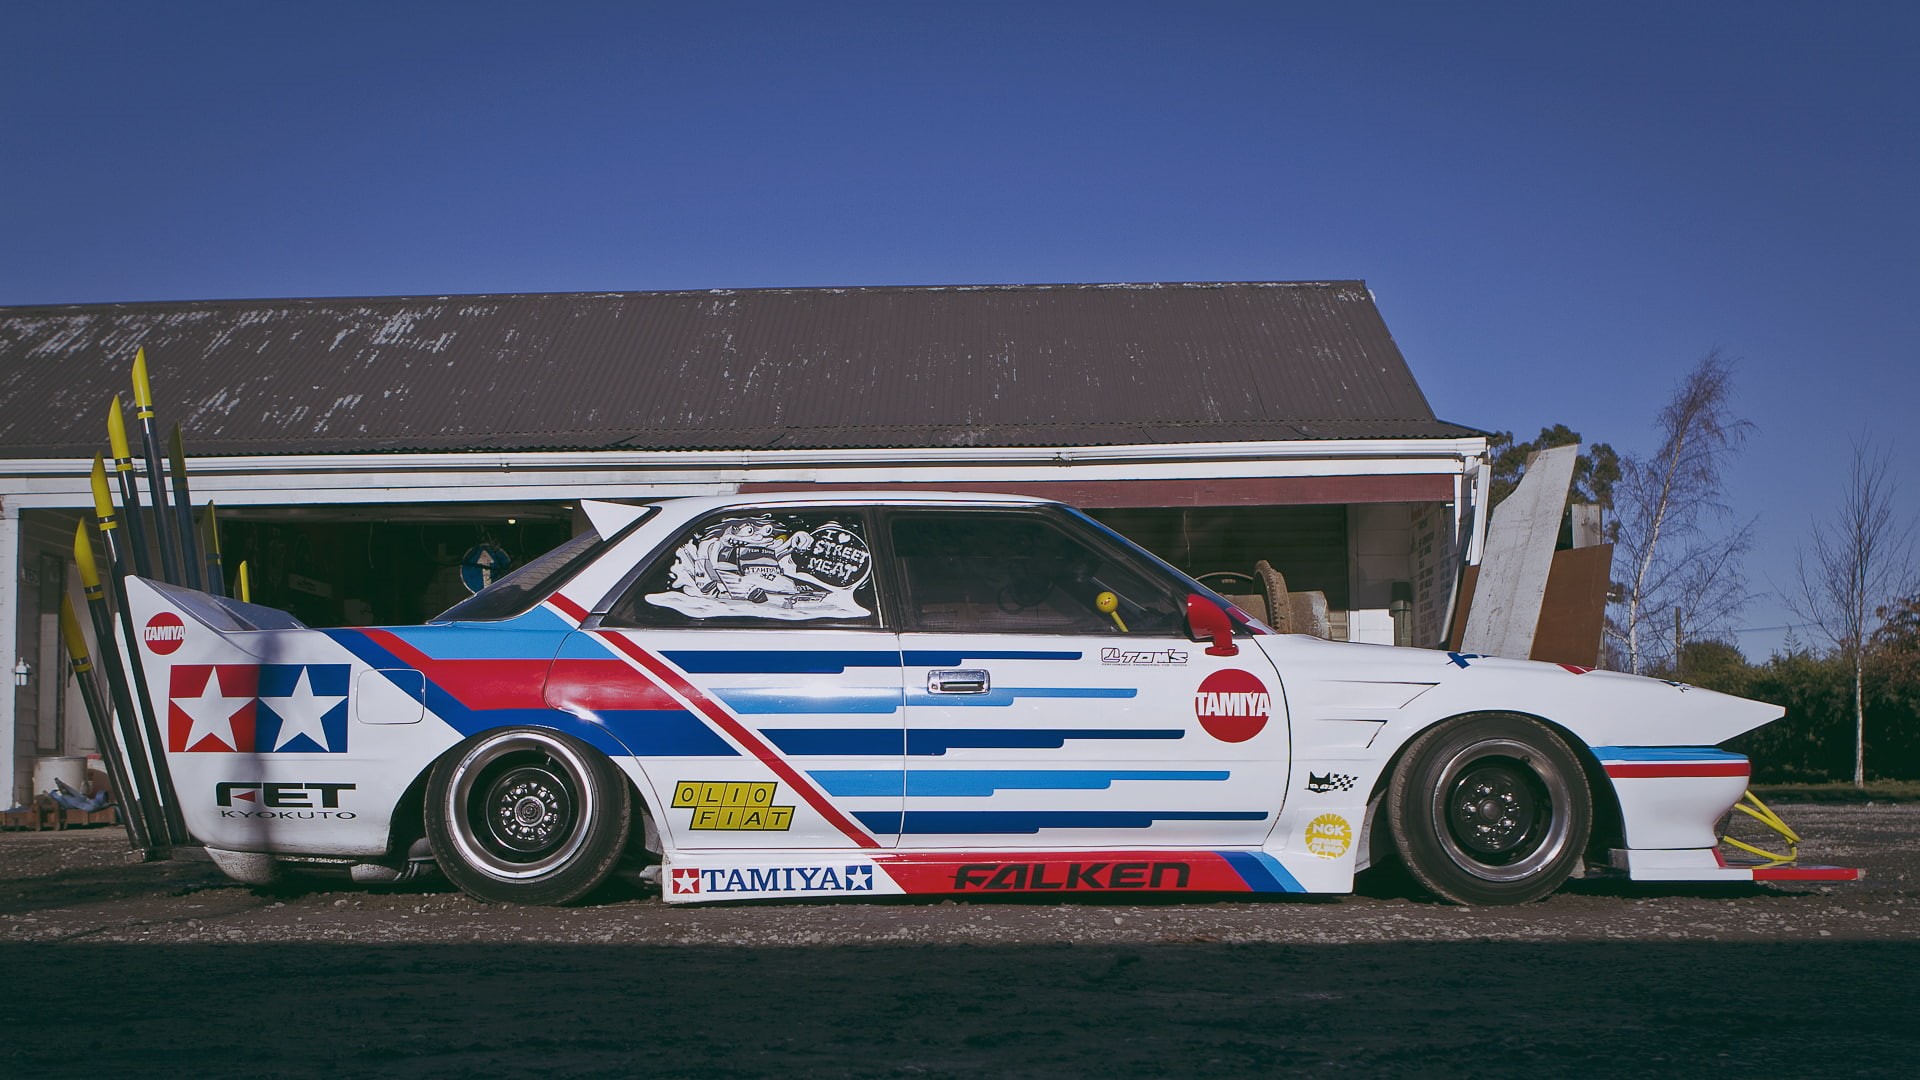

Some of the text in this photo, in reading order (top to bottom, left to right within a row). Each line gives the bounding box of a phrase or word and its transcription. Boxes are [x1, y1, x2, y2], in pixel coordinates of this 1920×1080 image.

[822, 530, 836, 540] I
[813, 540, 869, 564] STREET
[807, 557, 858, 581] MEAT
[145, 625, 185, 641] TAMIYA
[1196, 691, 1271, 717] TAMIYA
[216, 782, 356, 808] FET
[681, 787, 767, 803] OLIO
[221, 811, 357, 820] KYOKUTO
[699, 811, 788, 826] FIAT
[1312, 824, 1345, 836] NGK
[701, 867, 844, 893] TAMIYA
[949, 862, 1191, 890] FALKEN
